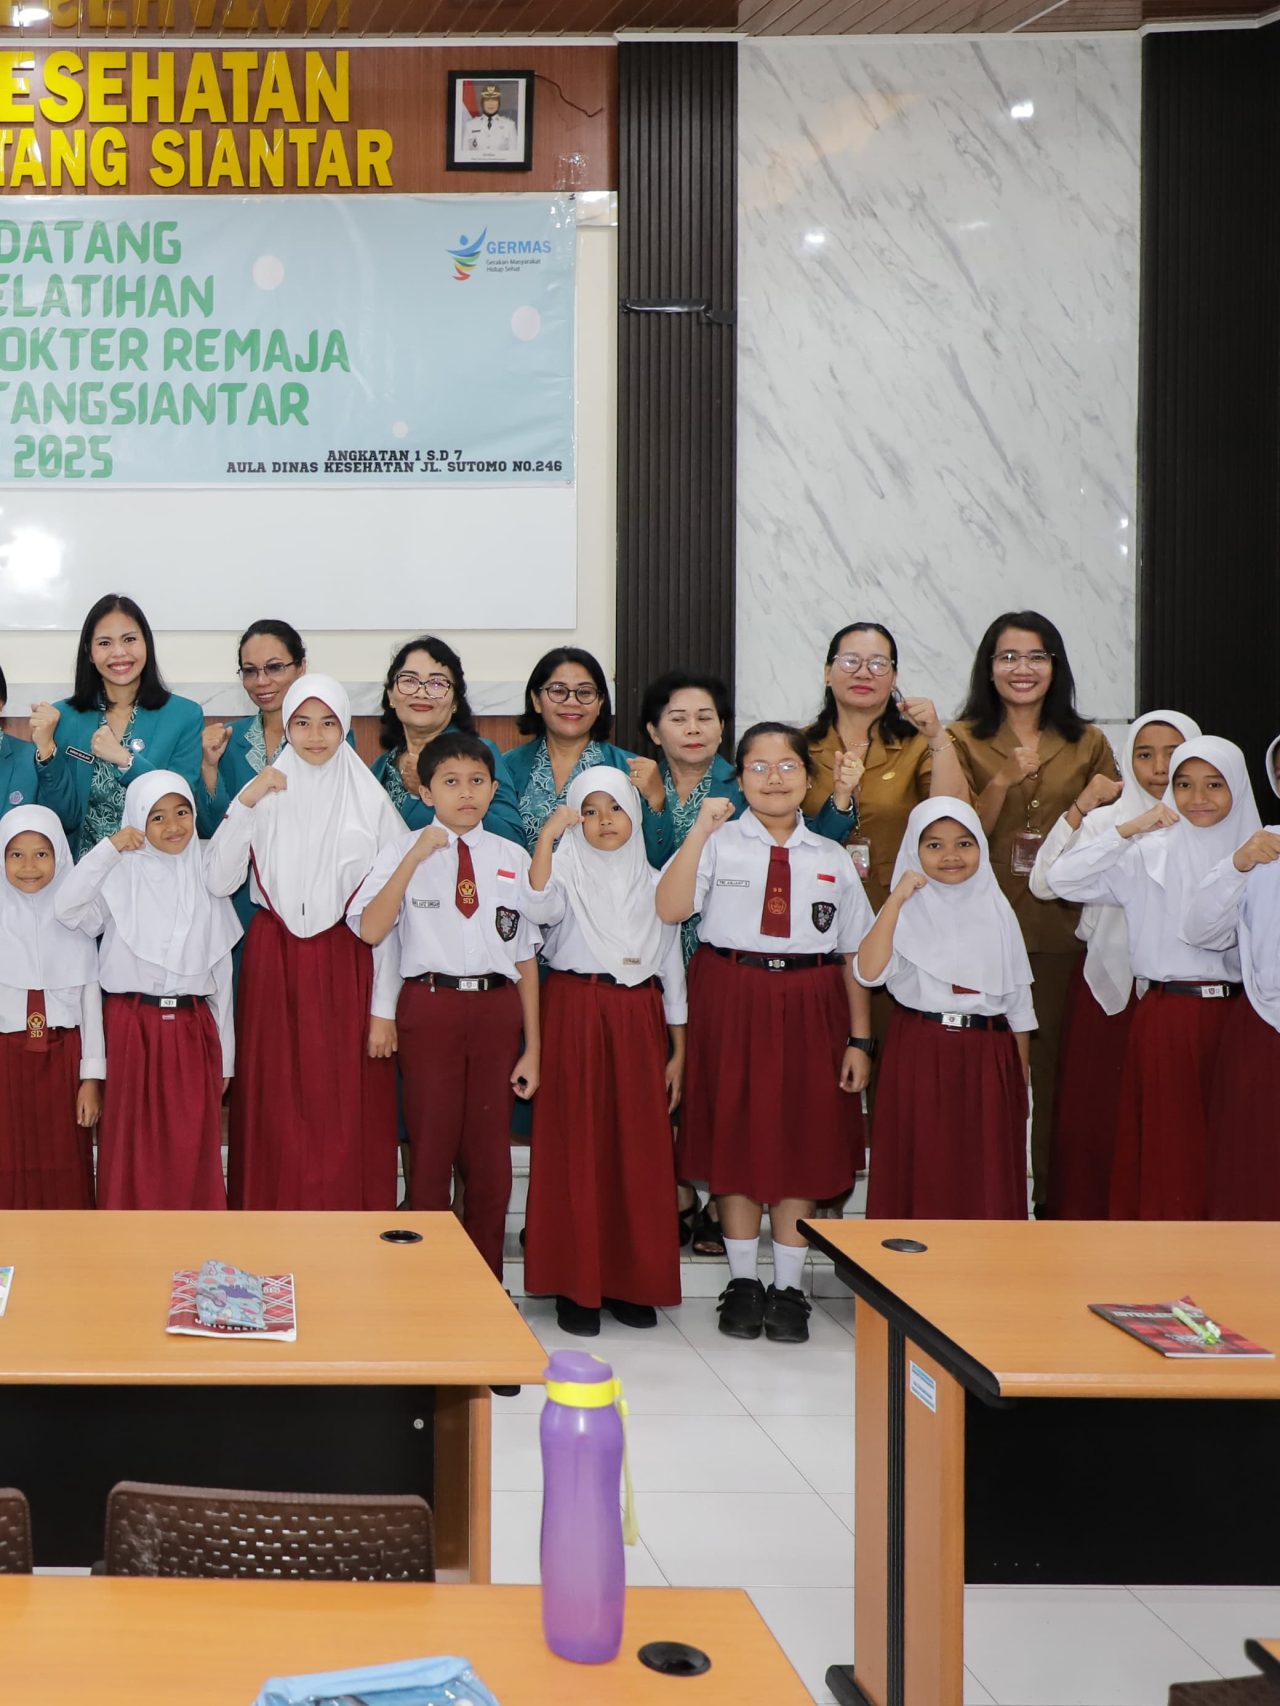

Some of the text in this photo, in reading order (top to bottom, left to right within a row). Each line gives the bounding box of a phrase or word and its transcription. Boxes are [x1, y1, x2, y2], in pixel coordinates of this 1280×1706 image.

[149, 128, 394, 188] SIANTAR
[486, 240, 552, 254] GERMAS
[163, 328, 351, 374] REMAJA
[15, 436, 113, 479] 2025
[327, 449, 463, 461] ANGKATAN 1 S.D 7
[226, 460, 563, 473] AULA DINAS KESEHATAN JL. SUTOMO NO.246
[30, 1030, 44, 1038] SD
